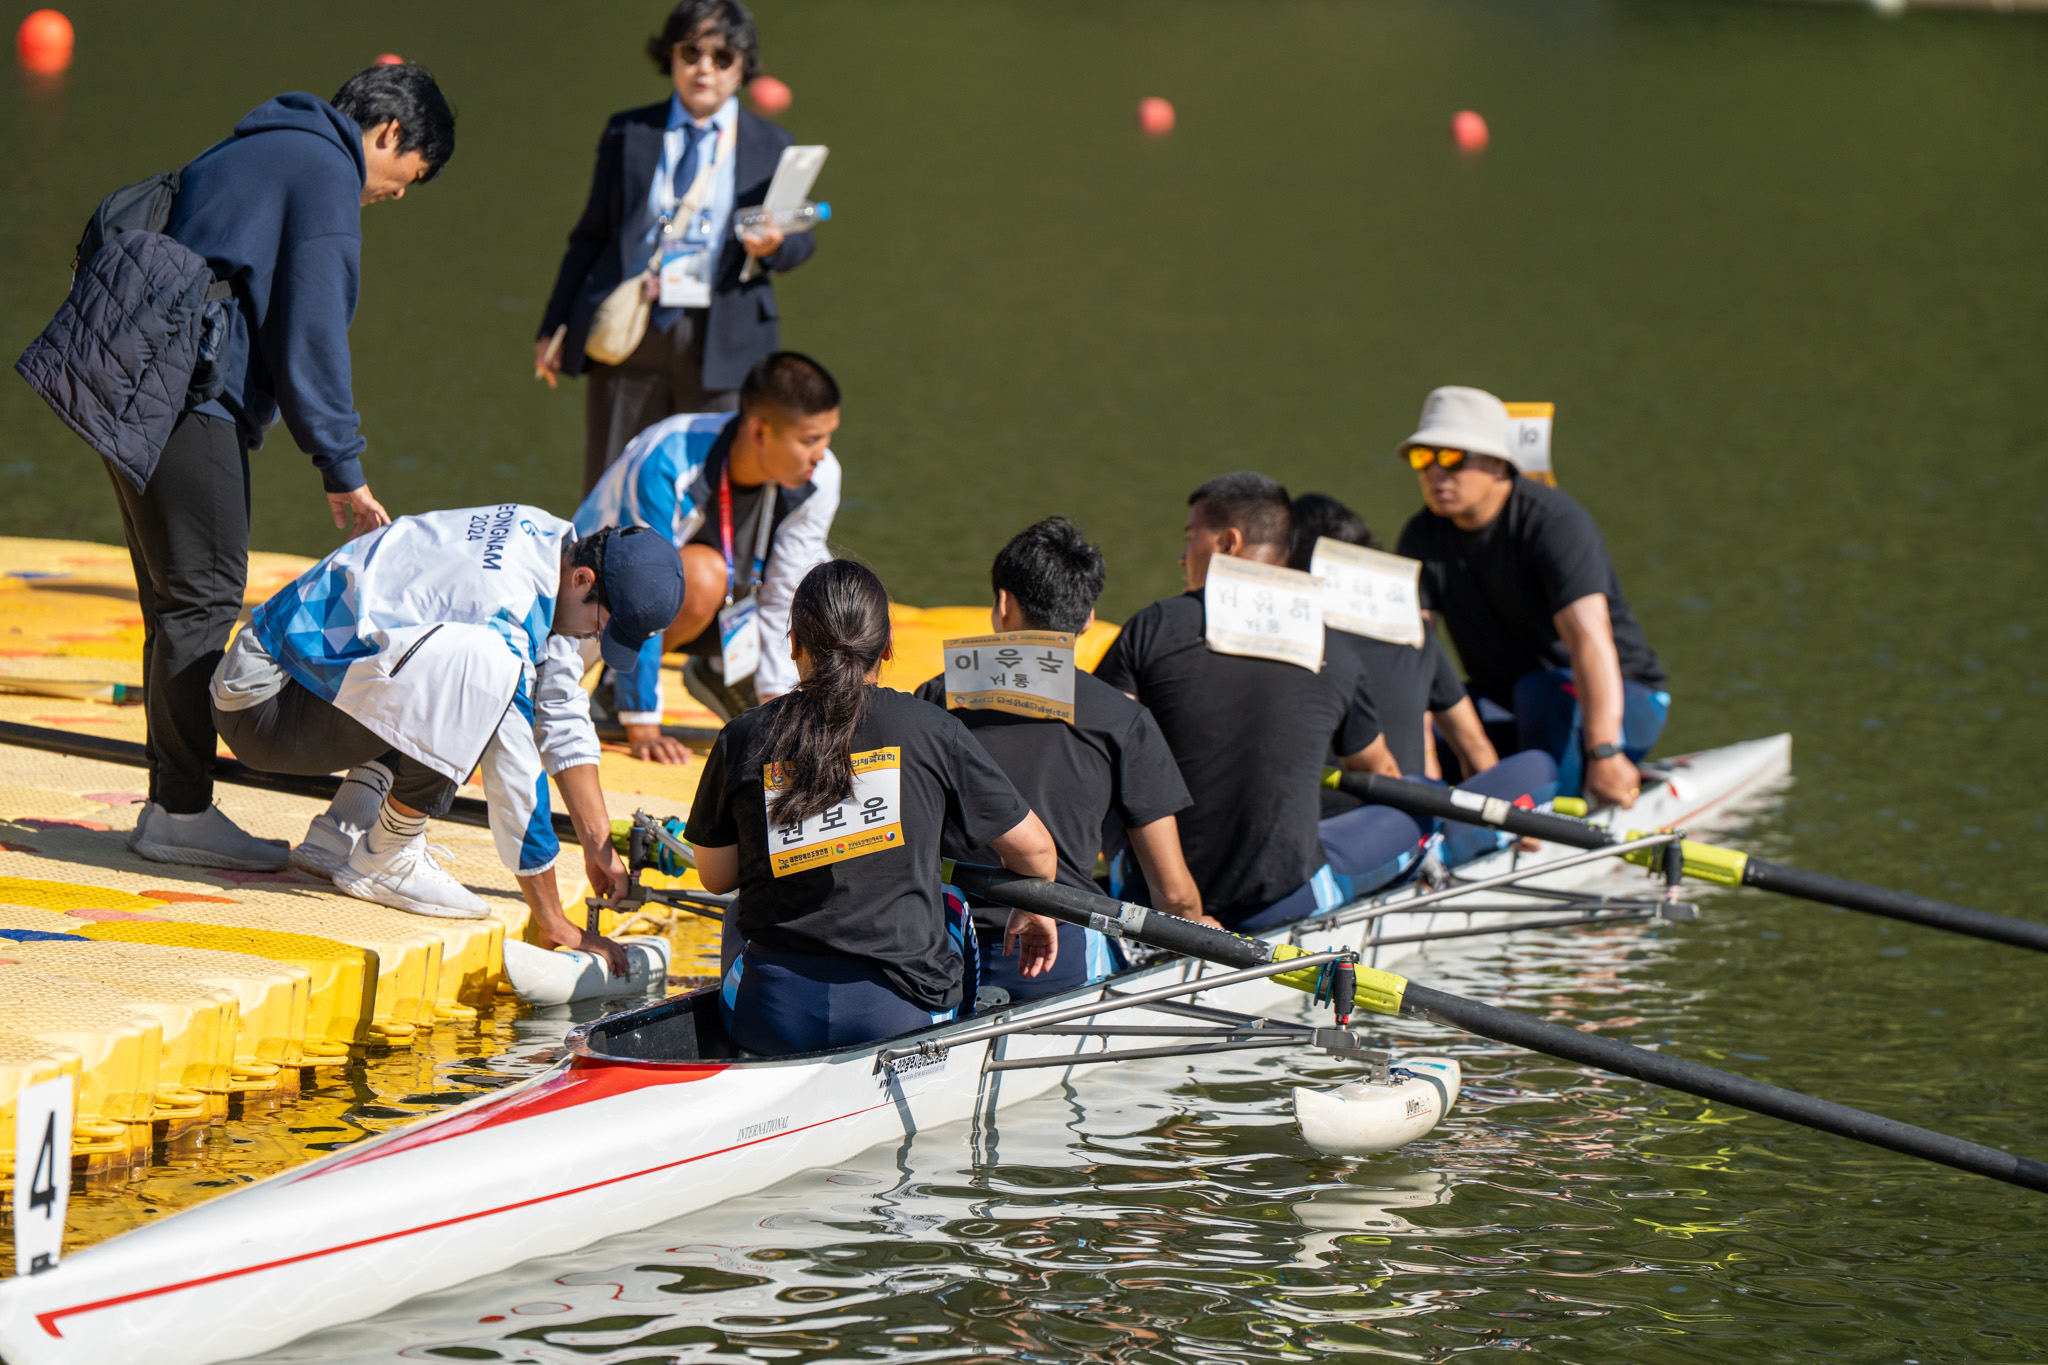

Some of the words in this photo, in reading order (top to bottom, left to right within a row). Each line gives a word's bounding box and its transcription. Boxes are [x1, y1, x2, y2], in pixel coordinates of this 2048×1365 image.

[465, 514, 490, 542] 2024
[736, 1115, 790, 1142] INTERNATIONAL
[29, 1110, 57, 1220] 4
